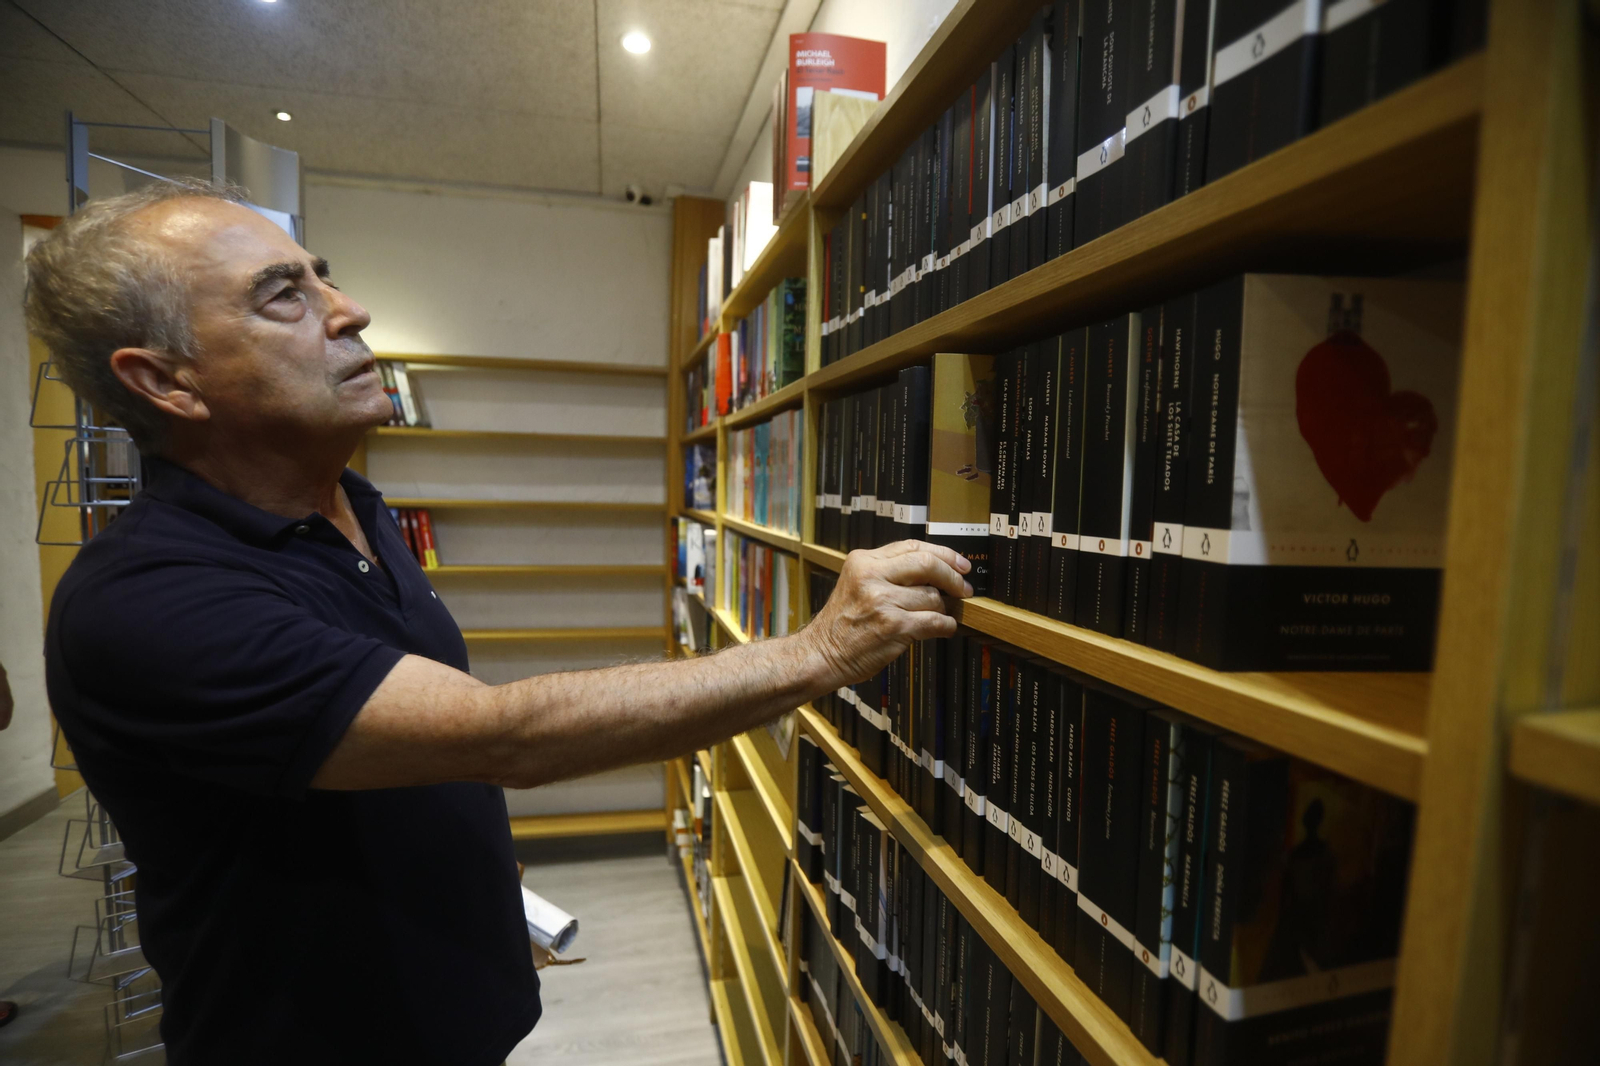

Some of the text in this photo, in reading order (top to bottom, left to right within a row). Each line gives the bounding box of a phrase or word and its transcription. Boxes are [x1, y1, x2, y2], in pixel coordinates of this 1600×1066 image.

[1103, 36, 1109, 48] LA
[796, 50, 832, 58] MICHAEL
[796, 58, 835, 67] BURLEIGH
[1106, 92, 1112, 105] DE
[1019, 133, 1023, 143] LA
[1173, 328, 1182, 389] HAWTHORNE
[1003, 390, 1008, 401] DE
[1175, 401, 1181, 414] LA
[1210, 373, 1220, 438] NOTRE-DAME
[1173, 444, 1180, 457] DE
[1209, 441, 1216, 454] DE
[1164, 450, 1172, 492] TEJADOS
[1303, 593, 1391, 605] VICTOR HUGO
[1357, 626, 1372, 636] DE
[1014, 754, 1019, 763] DE
[1030, 782, 1036, 792] DE
[1151, 768, 1160, 806] GALDÓS
[1181, 774, 1198, 908] PÉREZ GALDÓS MARIANELA
[1212, 780, 1230, 941] PÉREZ GALDÓS DOÑA PERFECTA
